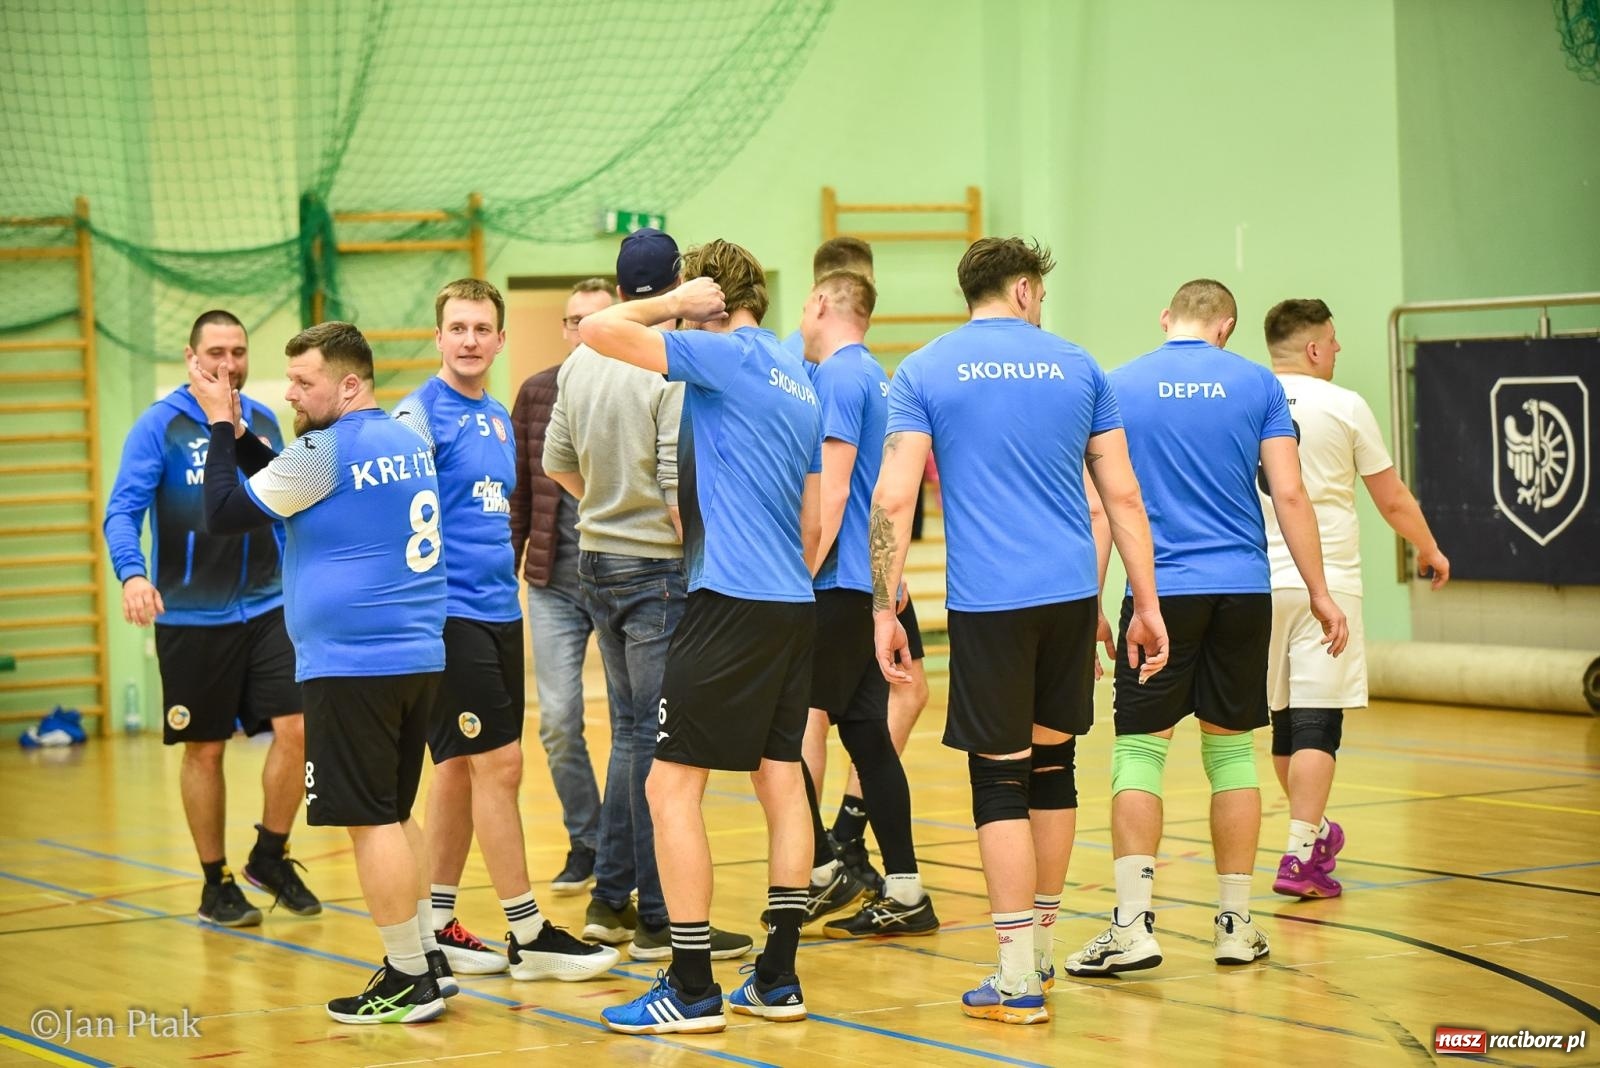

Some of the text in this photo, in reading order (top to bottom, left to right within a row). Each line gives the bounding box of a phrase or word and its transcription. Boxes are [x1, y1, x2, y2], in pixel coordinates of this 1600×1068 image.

[957, 361, 1065, 382] SKORUPA
[1158, 381, 1227, 399] DEPTA
[476, 413, 491, 437] 5
[405, 489, 440, 573] 8
[658, 697, 667, 725] 6
[304, 761, 315, 788] 8
